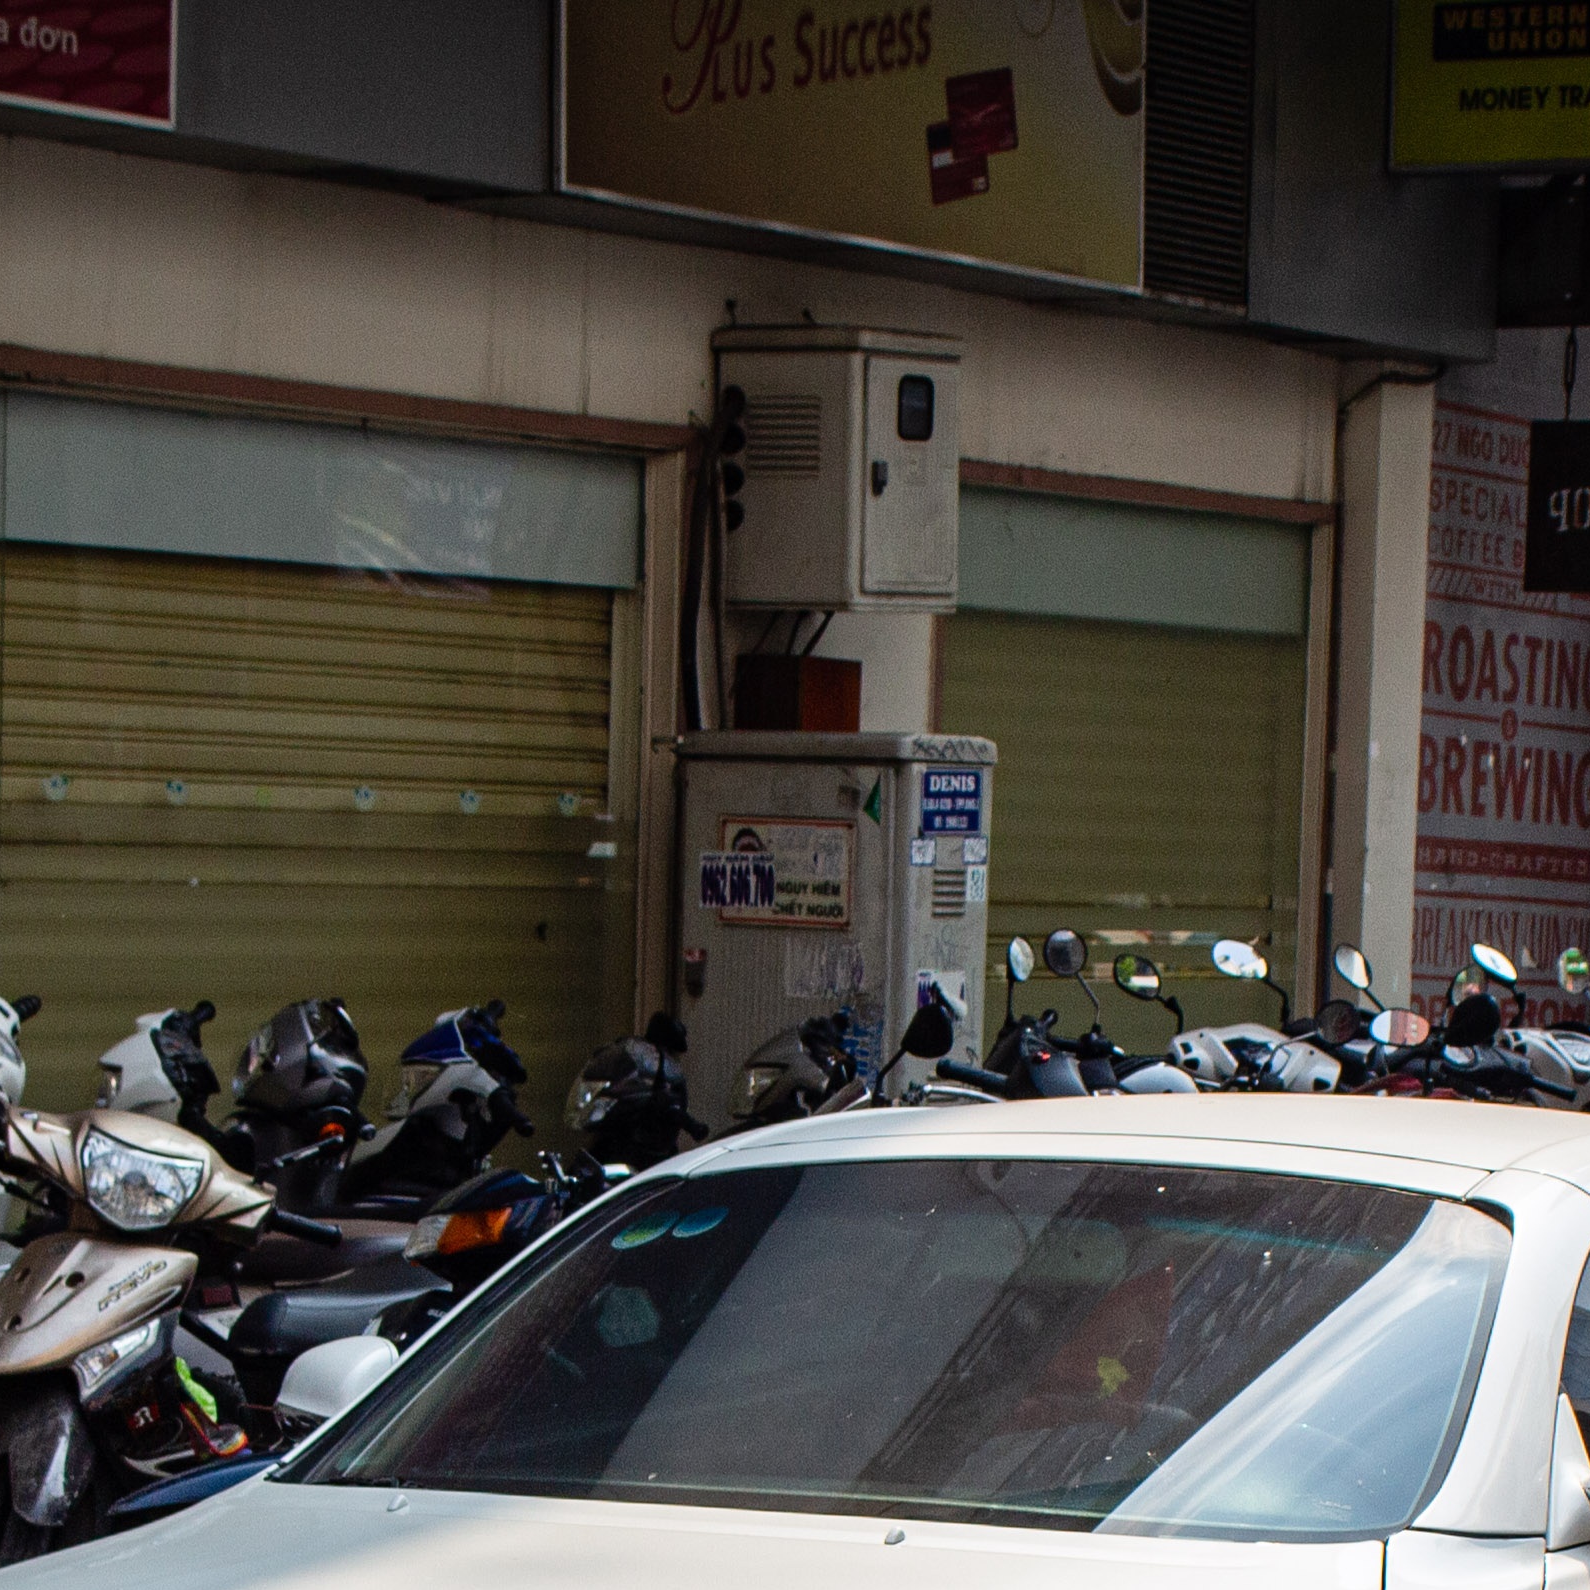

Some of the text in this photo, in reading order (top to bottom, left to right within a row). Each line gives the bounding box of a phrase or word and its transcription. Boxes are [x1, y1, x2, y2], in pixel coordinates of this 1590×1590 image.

[1441, 3, 1589, 30] WESTERN
[18, 15, 79, 56] đơn
[793, 5, 932, 88] Success
[1486, 27, 1589, 51] UNION
[1459, 86, 1550, 111] MONEY
[929, 774, 976, 792] DENIS
